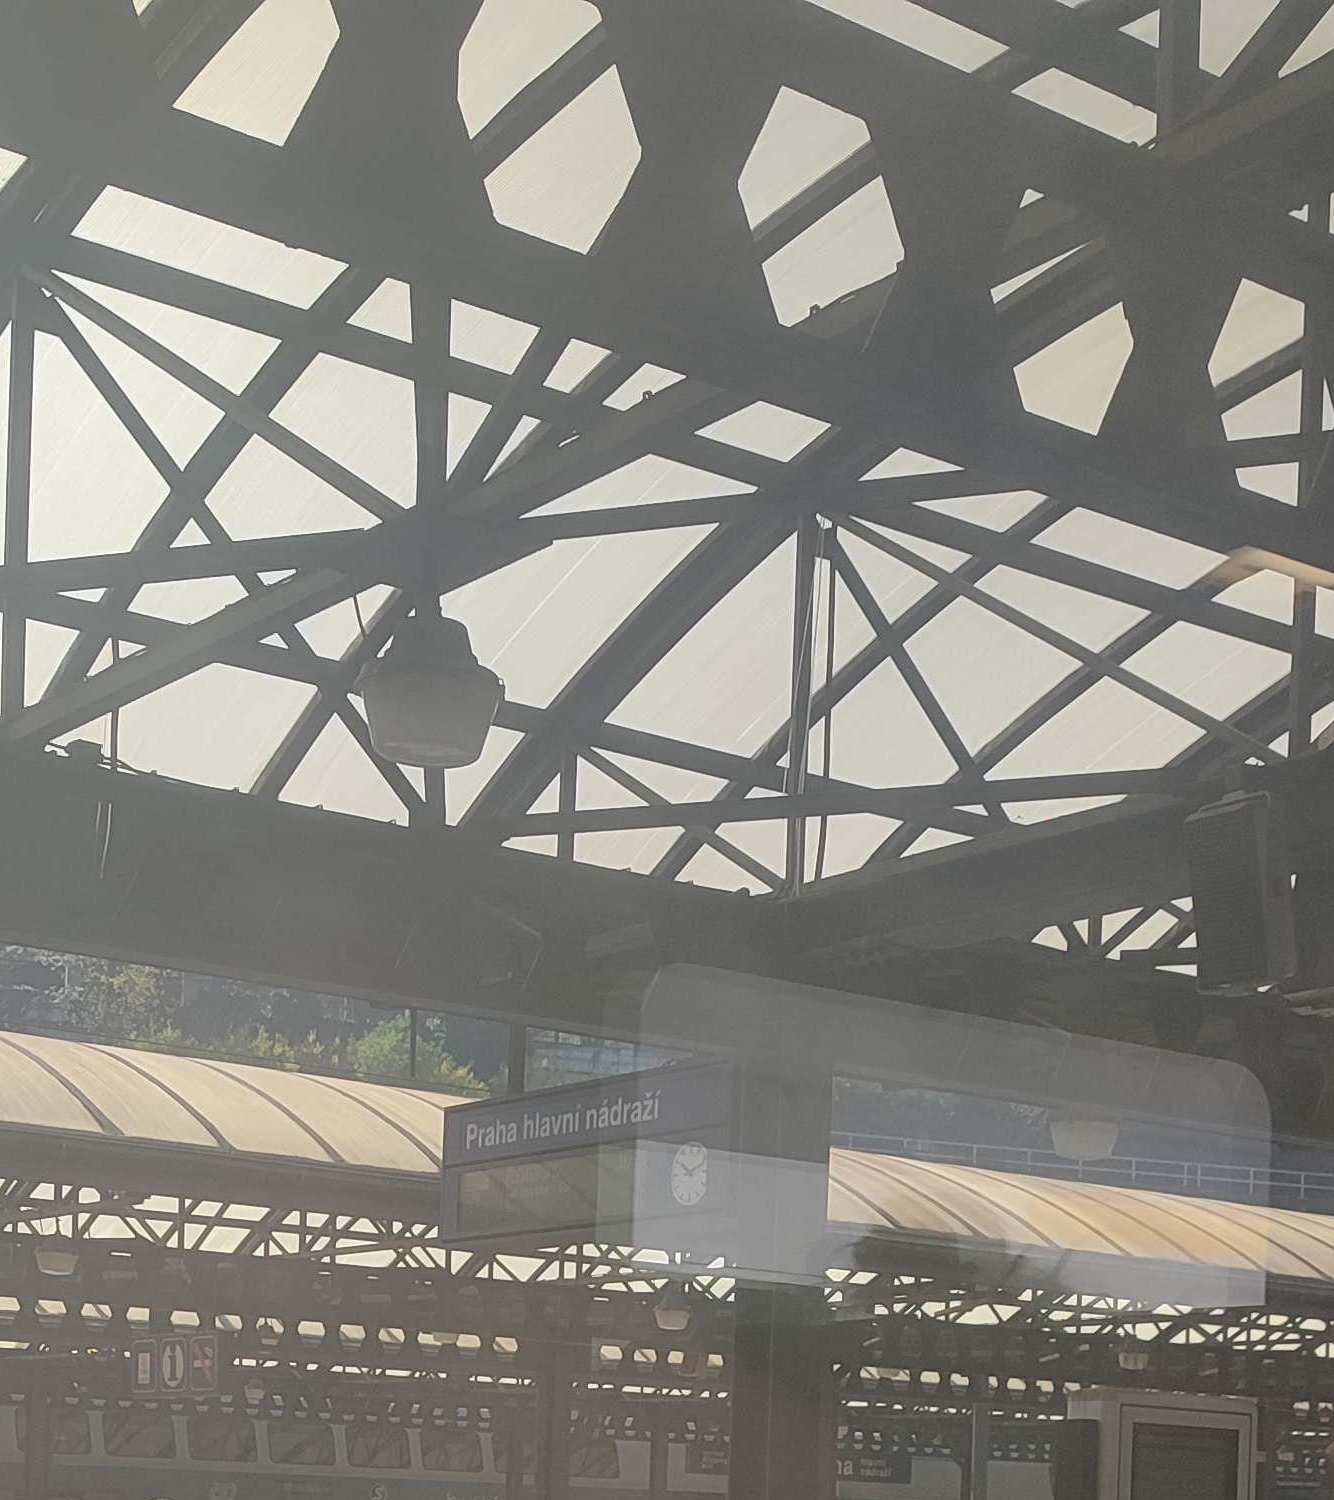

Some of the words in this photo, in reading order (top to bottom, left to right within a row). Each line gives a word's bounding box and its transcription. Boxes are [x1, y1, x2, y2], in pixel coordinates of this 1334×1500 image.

[465, 1119, 518, 1150] Praha
[522, 1104, 581, 1141] hlavní
[585, 1089, 662, 1130] nádraží
